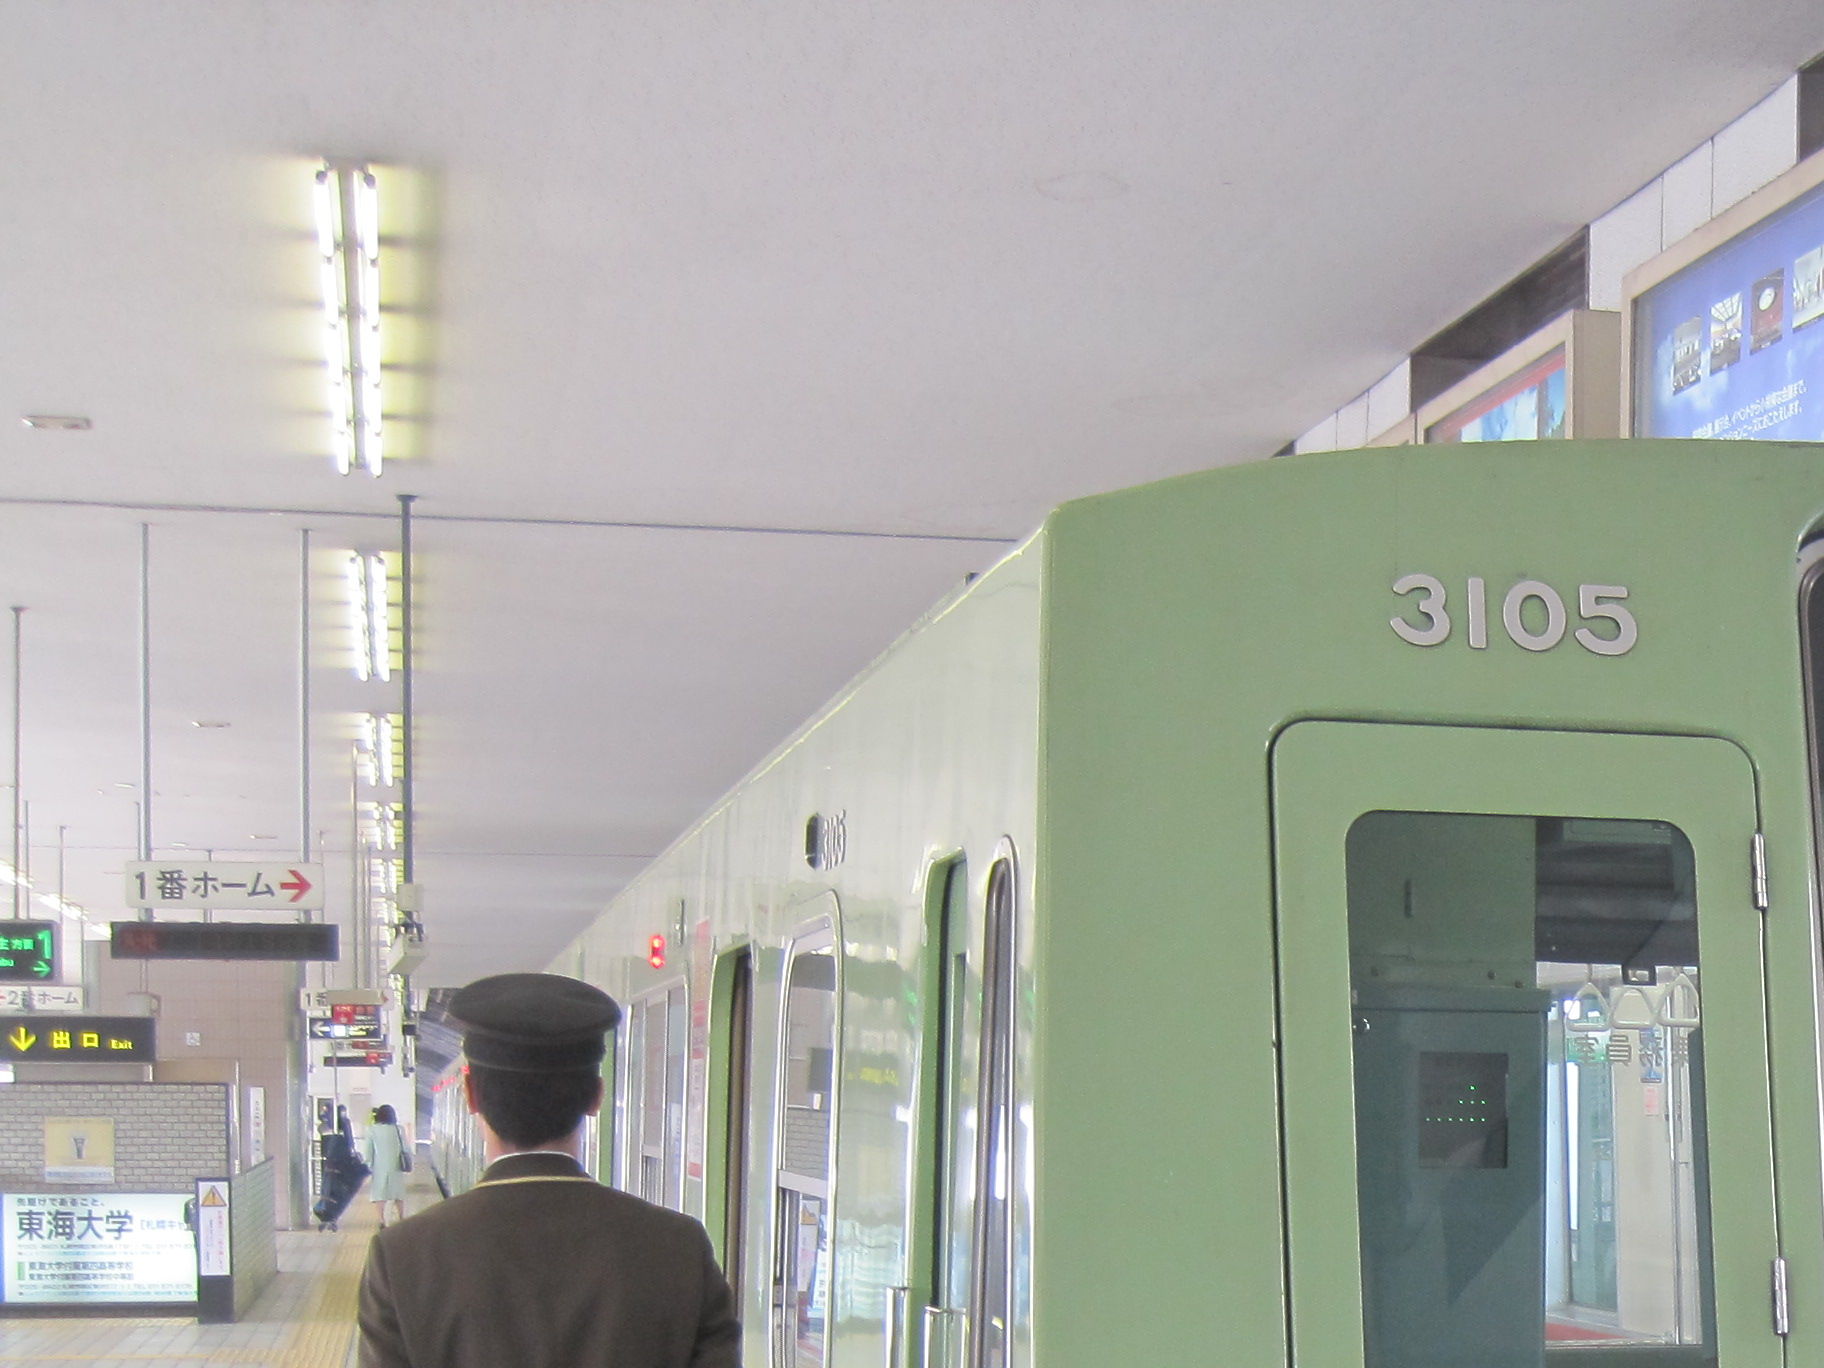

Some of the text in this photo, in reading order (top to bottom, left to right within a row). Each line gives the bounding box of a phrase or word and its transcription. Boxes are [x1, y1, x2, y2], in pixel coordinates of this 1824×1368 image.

[1390, 573, 1638, 656] 3105
[134, 869, 275, 901] 1番ホーム
[53, 1030, 133, 1050] 出口 Exit
[16, 1209, 134, 1241] 東海大学
